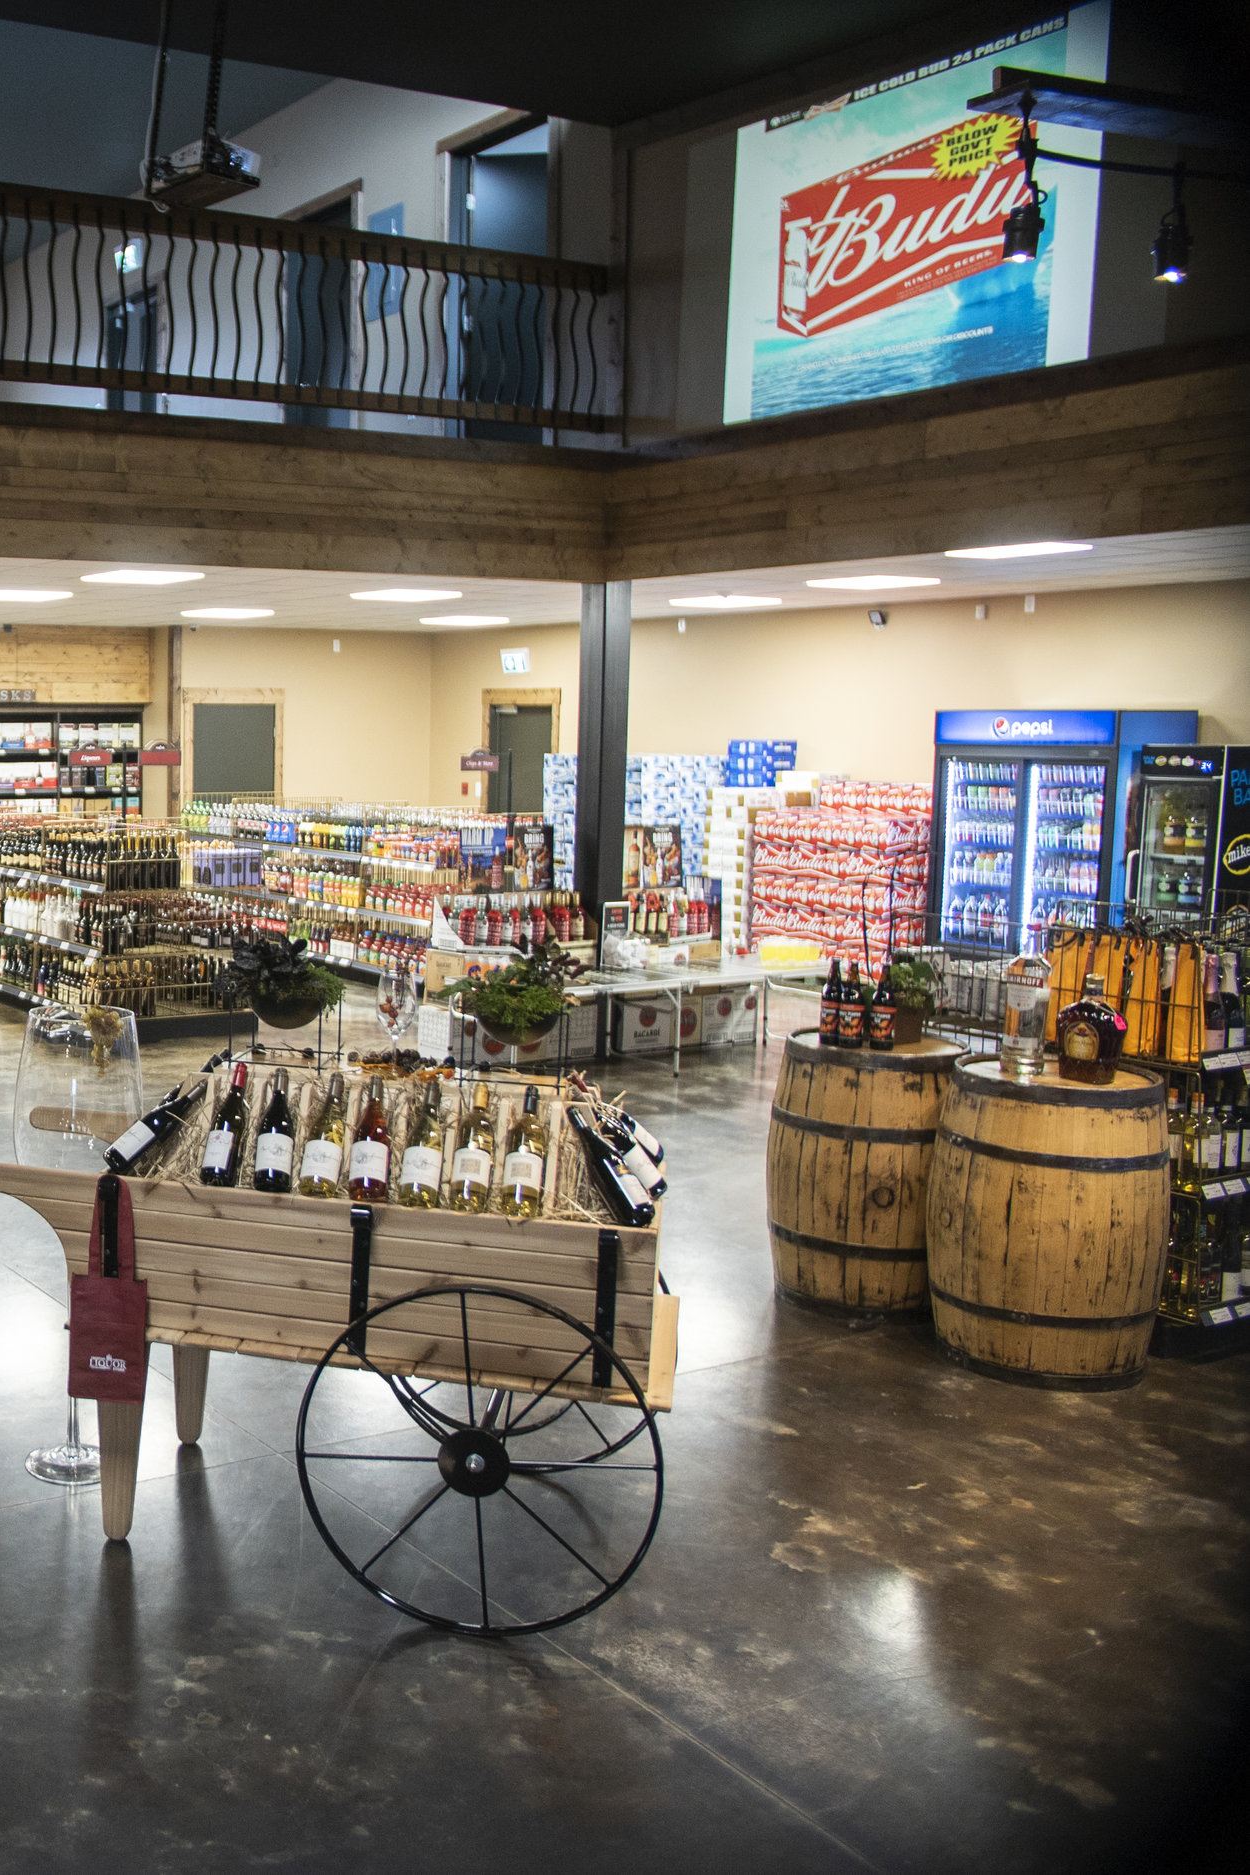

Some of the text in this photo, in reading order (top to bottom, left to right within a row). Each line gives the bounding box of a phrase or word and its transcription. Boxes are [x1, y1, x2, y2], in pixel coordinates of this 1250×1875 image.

[854, 16, 1066, 100] ICE COLD BUD 24 PACK CANS
[946, 122, 999, 148] BELOW
[949, 135, 993, 157] GOV'T
[949, 147, 993, 168] PRICE
[904, 272, 933, 289] KING
[936, 265, 951, 276] OF
[1011, 719, 1054, 737] pepsi
[1200, 762, 1212, 770] 34
[484, 828, 494, 845] UP
[524, 833, 545, 844] BRING
[652, 831, 673, 843] BRING
[89, 1357, 127, 1370] LIQUOR
